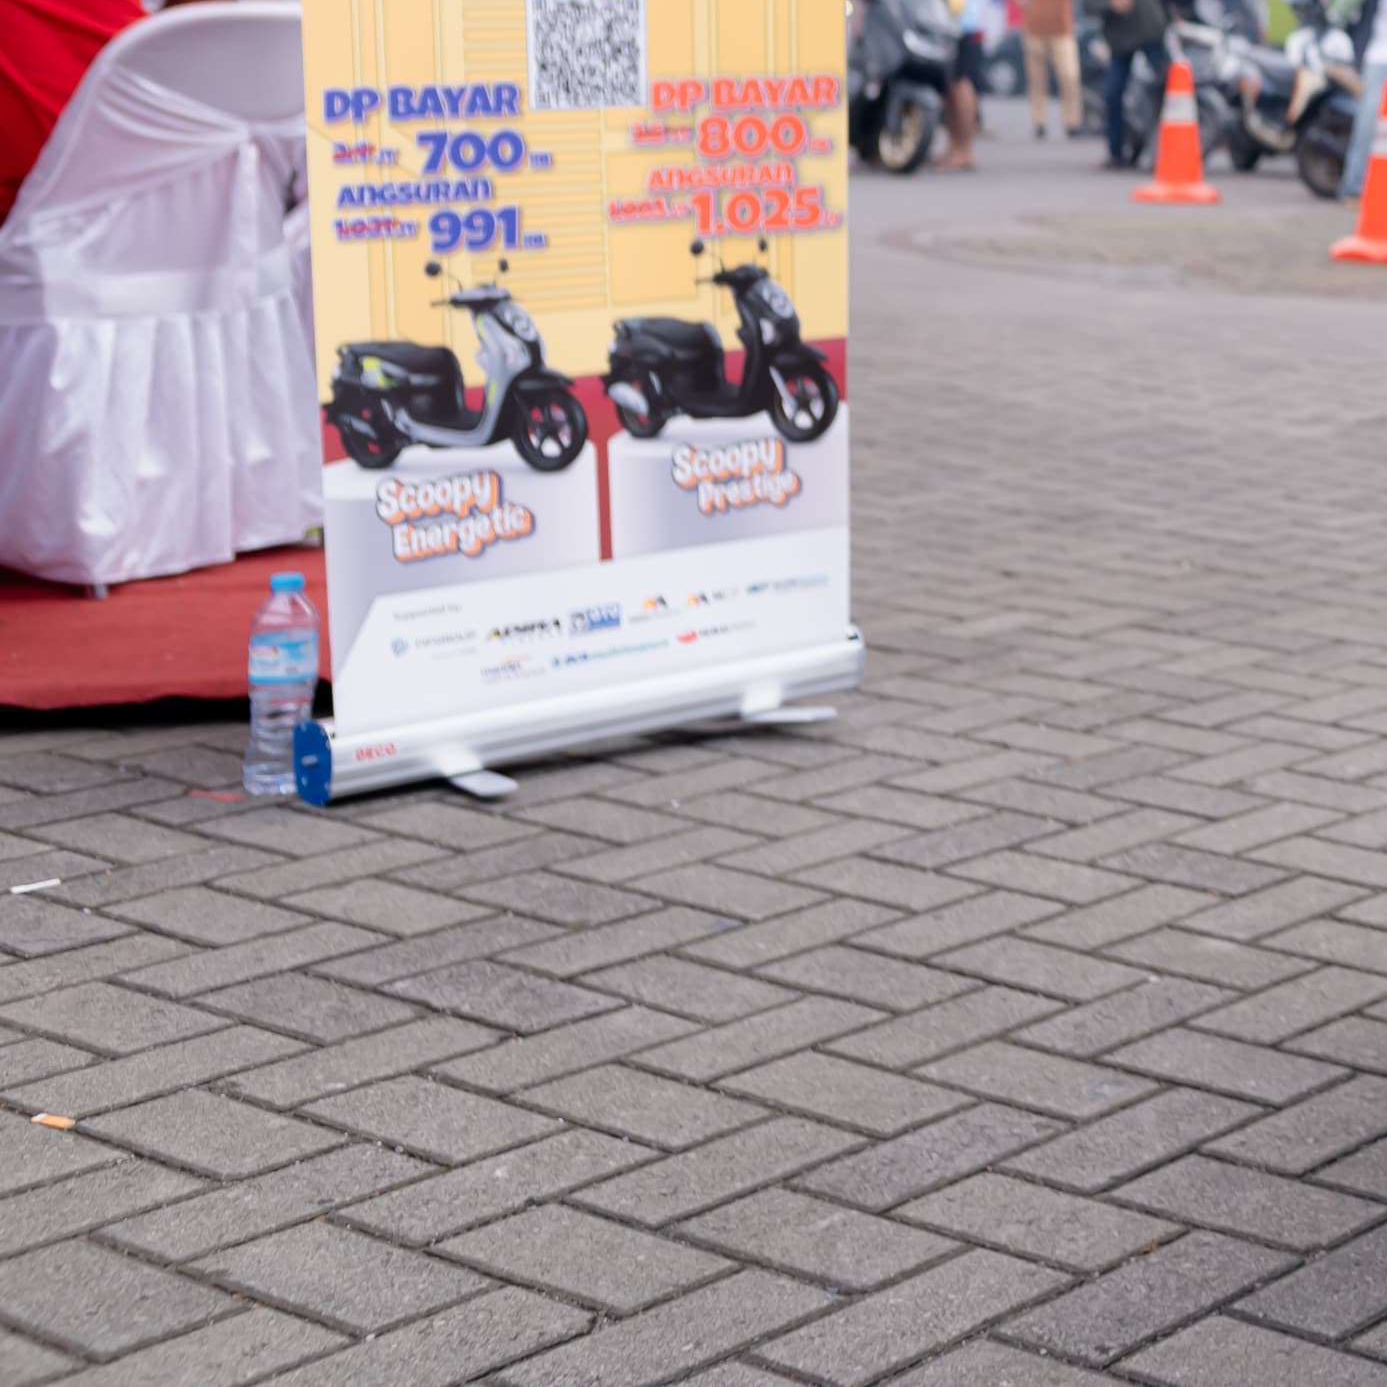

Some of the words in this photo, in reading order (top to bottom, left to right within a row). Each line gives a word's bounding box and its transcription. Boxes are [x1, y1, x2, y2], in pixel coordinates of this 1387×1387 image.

[324, 88, 379, 123] DP
[388, 83, 521, 121] BAYAR
[652, 78, 704, 112] DP
[711, 74, 839, 111] BAYAR
[415, 129, 525, 176] 700
[697, 114, 807, 158] 800
[336, 178, 494, 208] ANGSURAN
[648, 162, 797, 191] ANGSURAN
[428, 204, 520, 253] 991
[689, 187, 823, 235] 1.025
[672, 437, 784, 490] Scoopy
[376, 470, 501, 524] Scoopy
[699, 470, 799, 514] Prestige
[392, 502, 534, 560] Energetic
